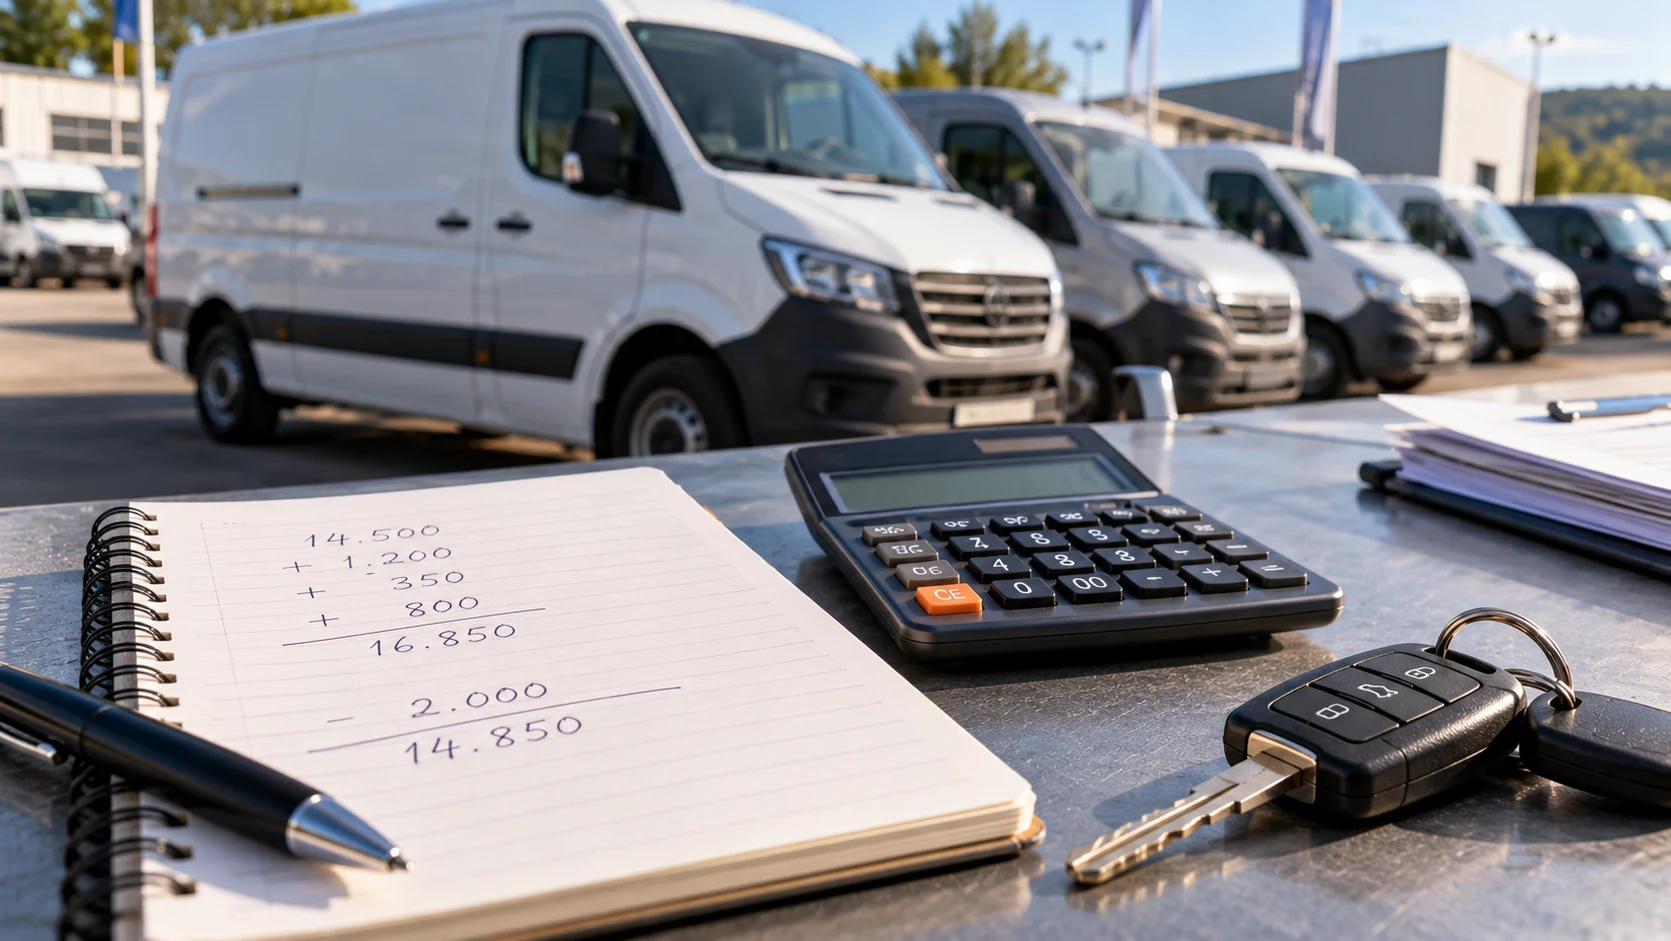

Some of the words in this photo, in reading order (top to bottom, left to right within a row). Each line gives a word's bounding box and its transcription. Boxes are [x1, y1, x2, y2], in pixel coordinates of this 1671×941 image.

[304, 524, 440, 548] 14.500
[342, 547, 452, 570] 1.200
[992, 558, 1010, 572] 4
[391, 571, 465, 591] 350
[1013, 581, 1033, 595] 0
[934, 588, 967, 602] CE
[405, 596, 479, 618] 800
[369, 623, 516, 656] 16.850
[411, 682, 548, 719] 2.000
[404, 716, 582, 764] 14.850
